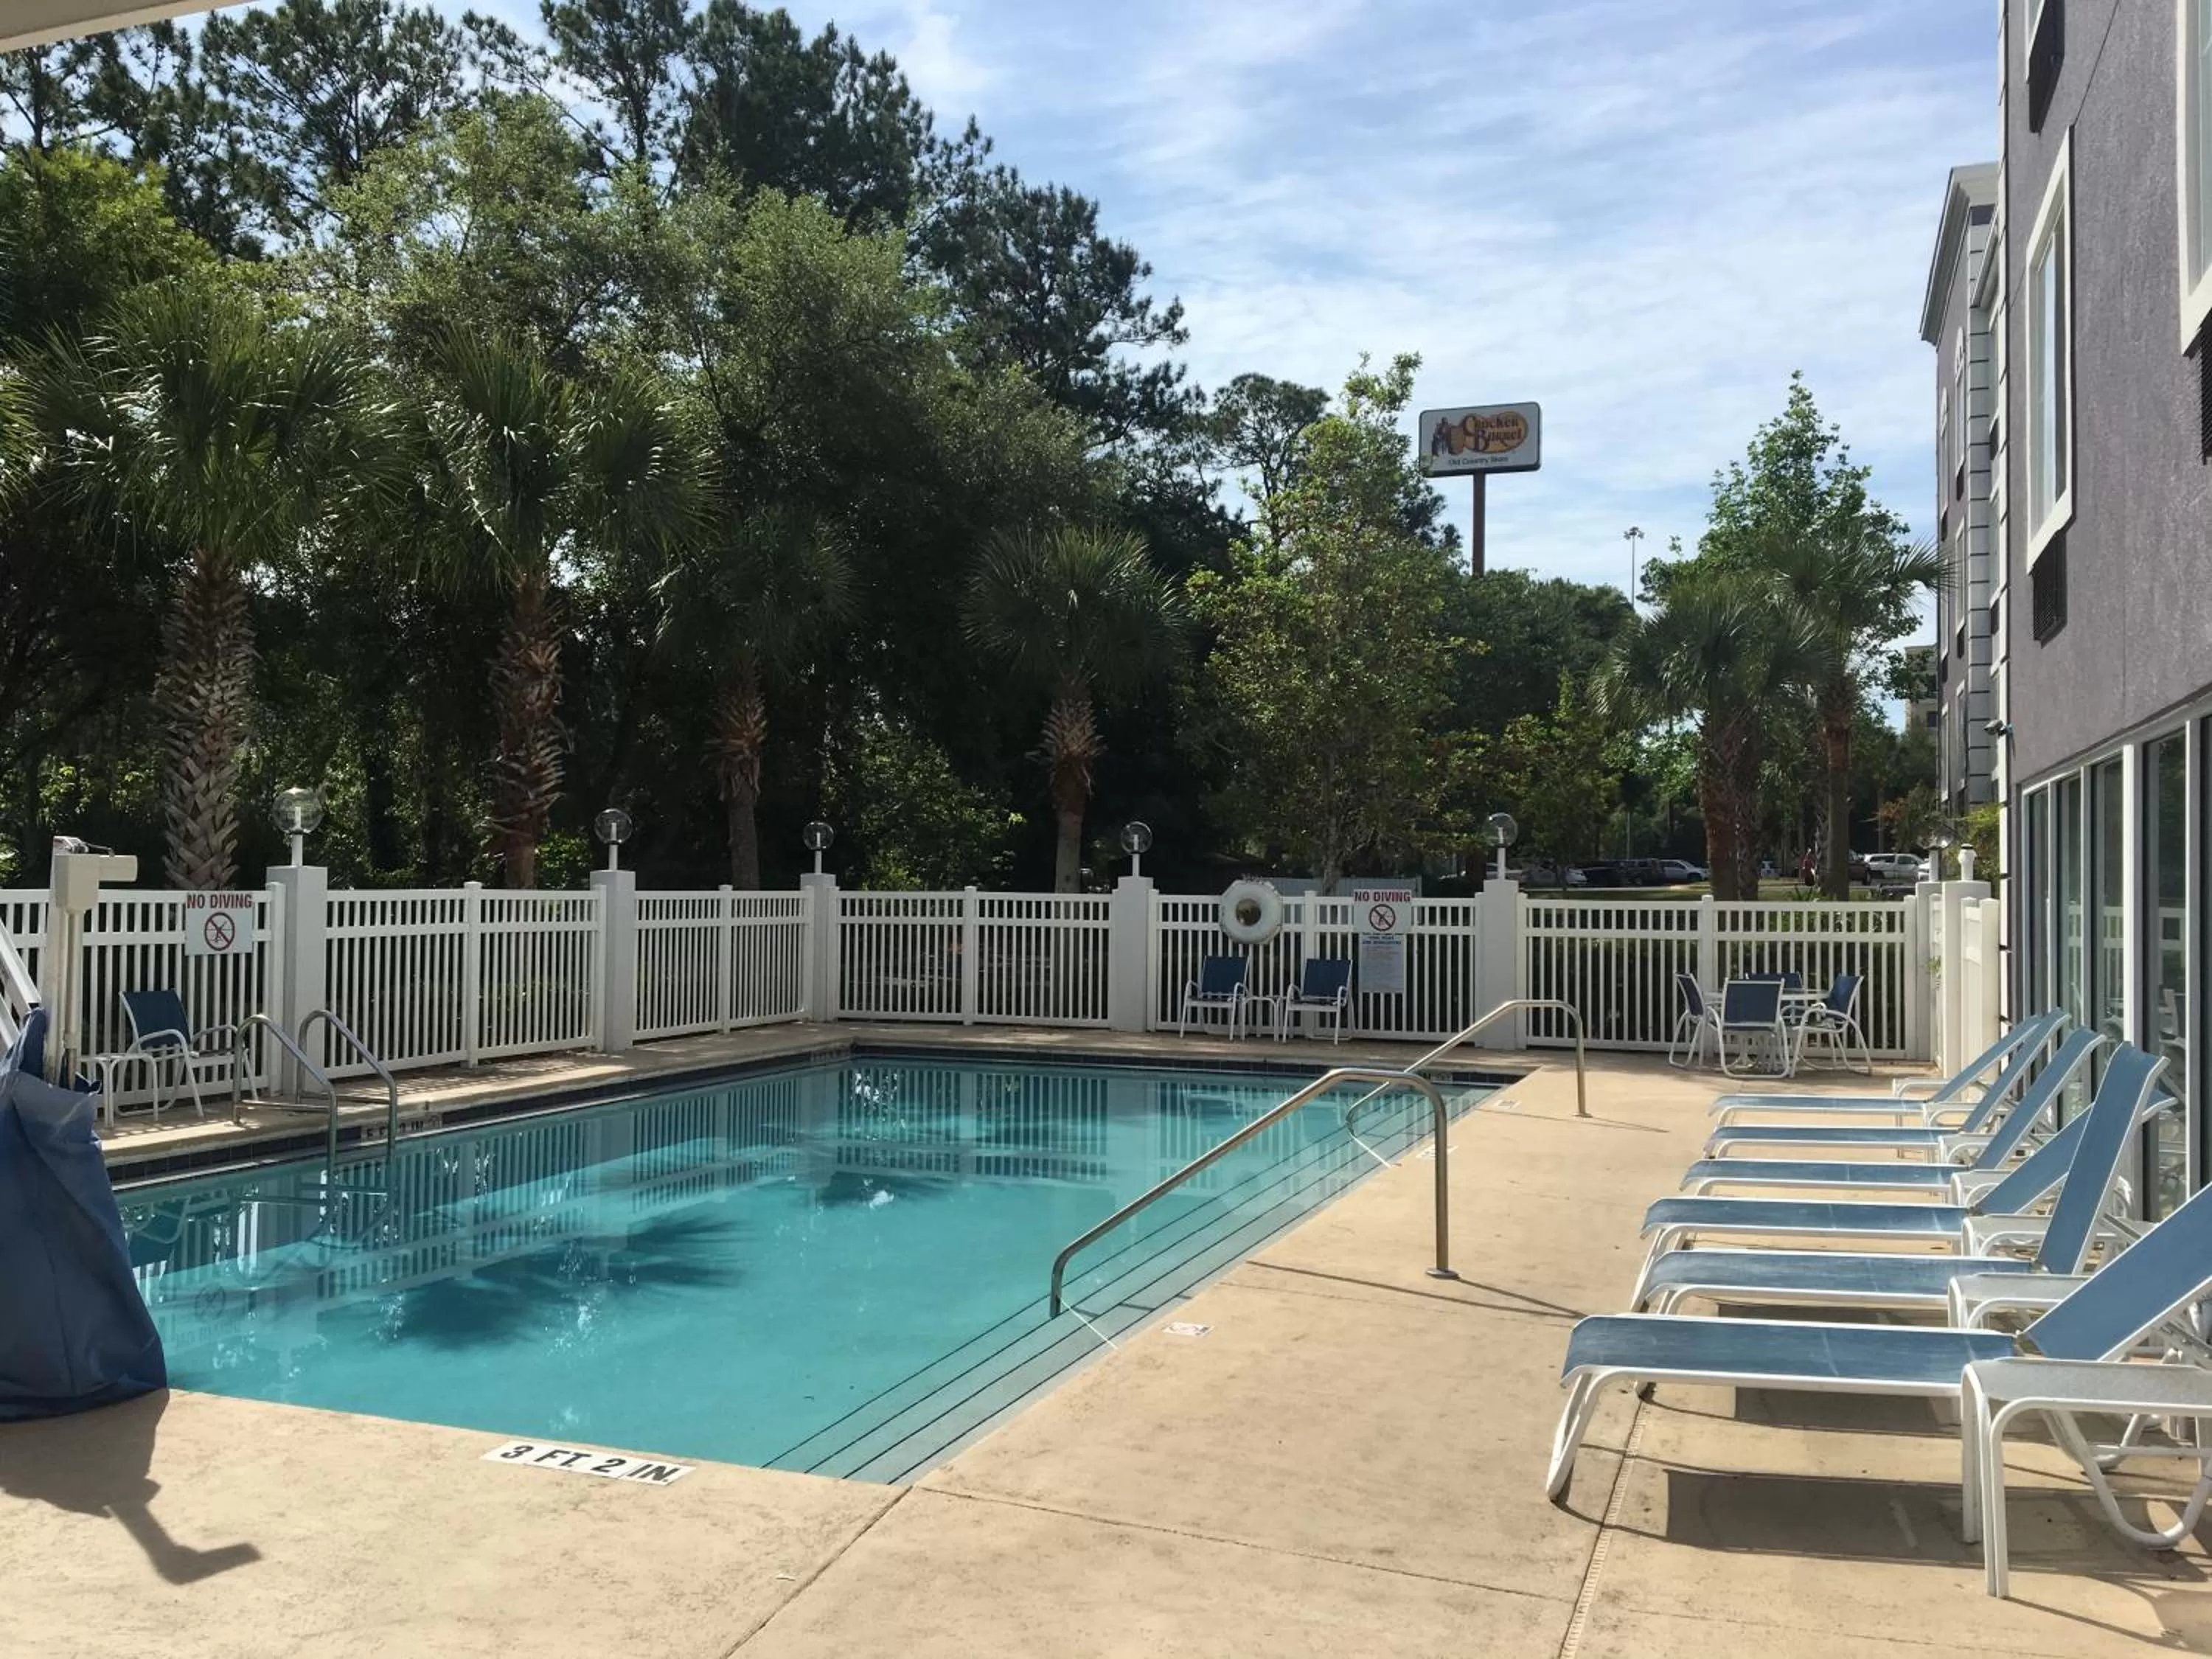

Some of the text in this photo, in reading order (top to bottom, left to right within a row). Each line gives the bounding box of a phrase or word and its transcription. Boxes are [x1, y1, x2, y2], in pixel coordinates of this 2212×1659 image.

[187, 893, 253, 909] NO DIVING
[1354, 891, 1411, 902] NO DIVING
[500, 1444, 535, 1459] 3
[591, 1458, 627, 1473] 2
